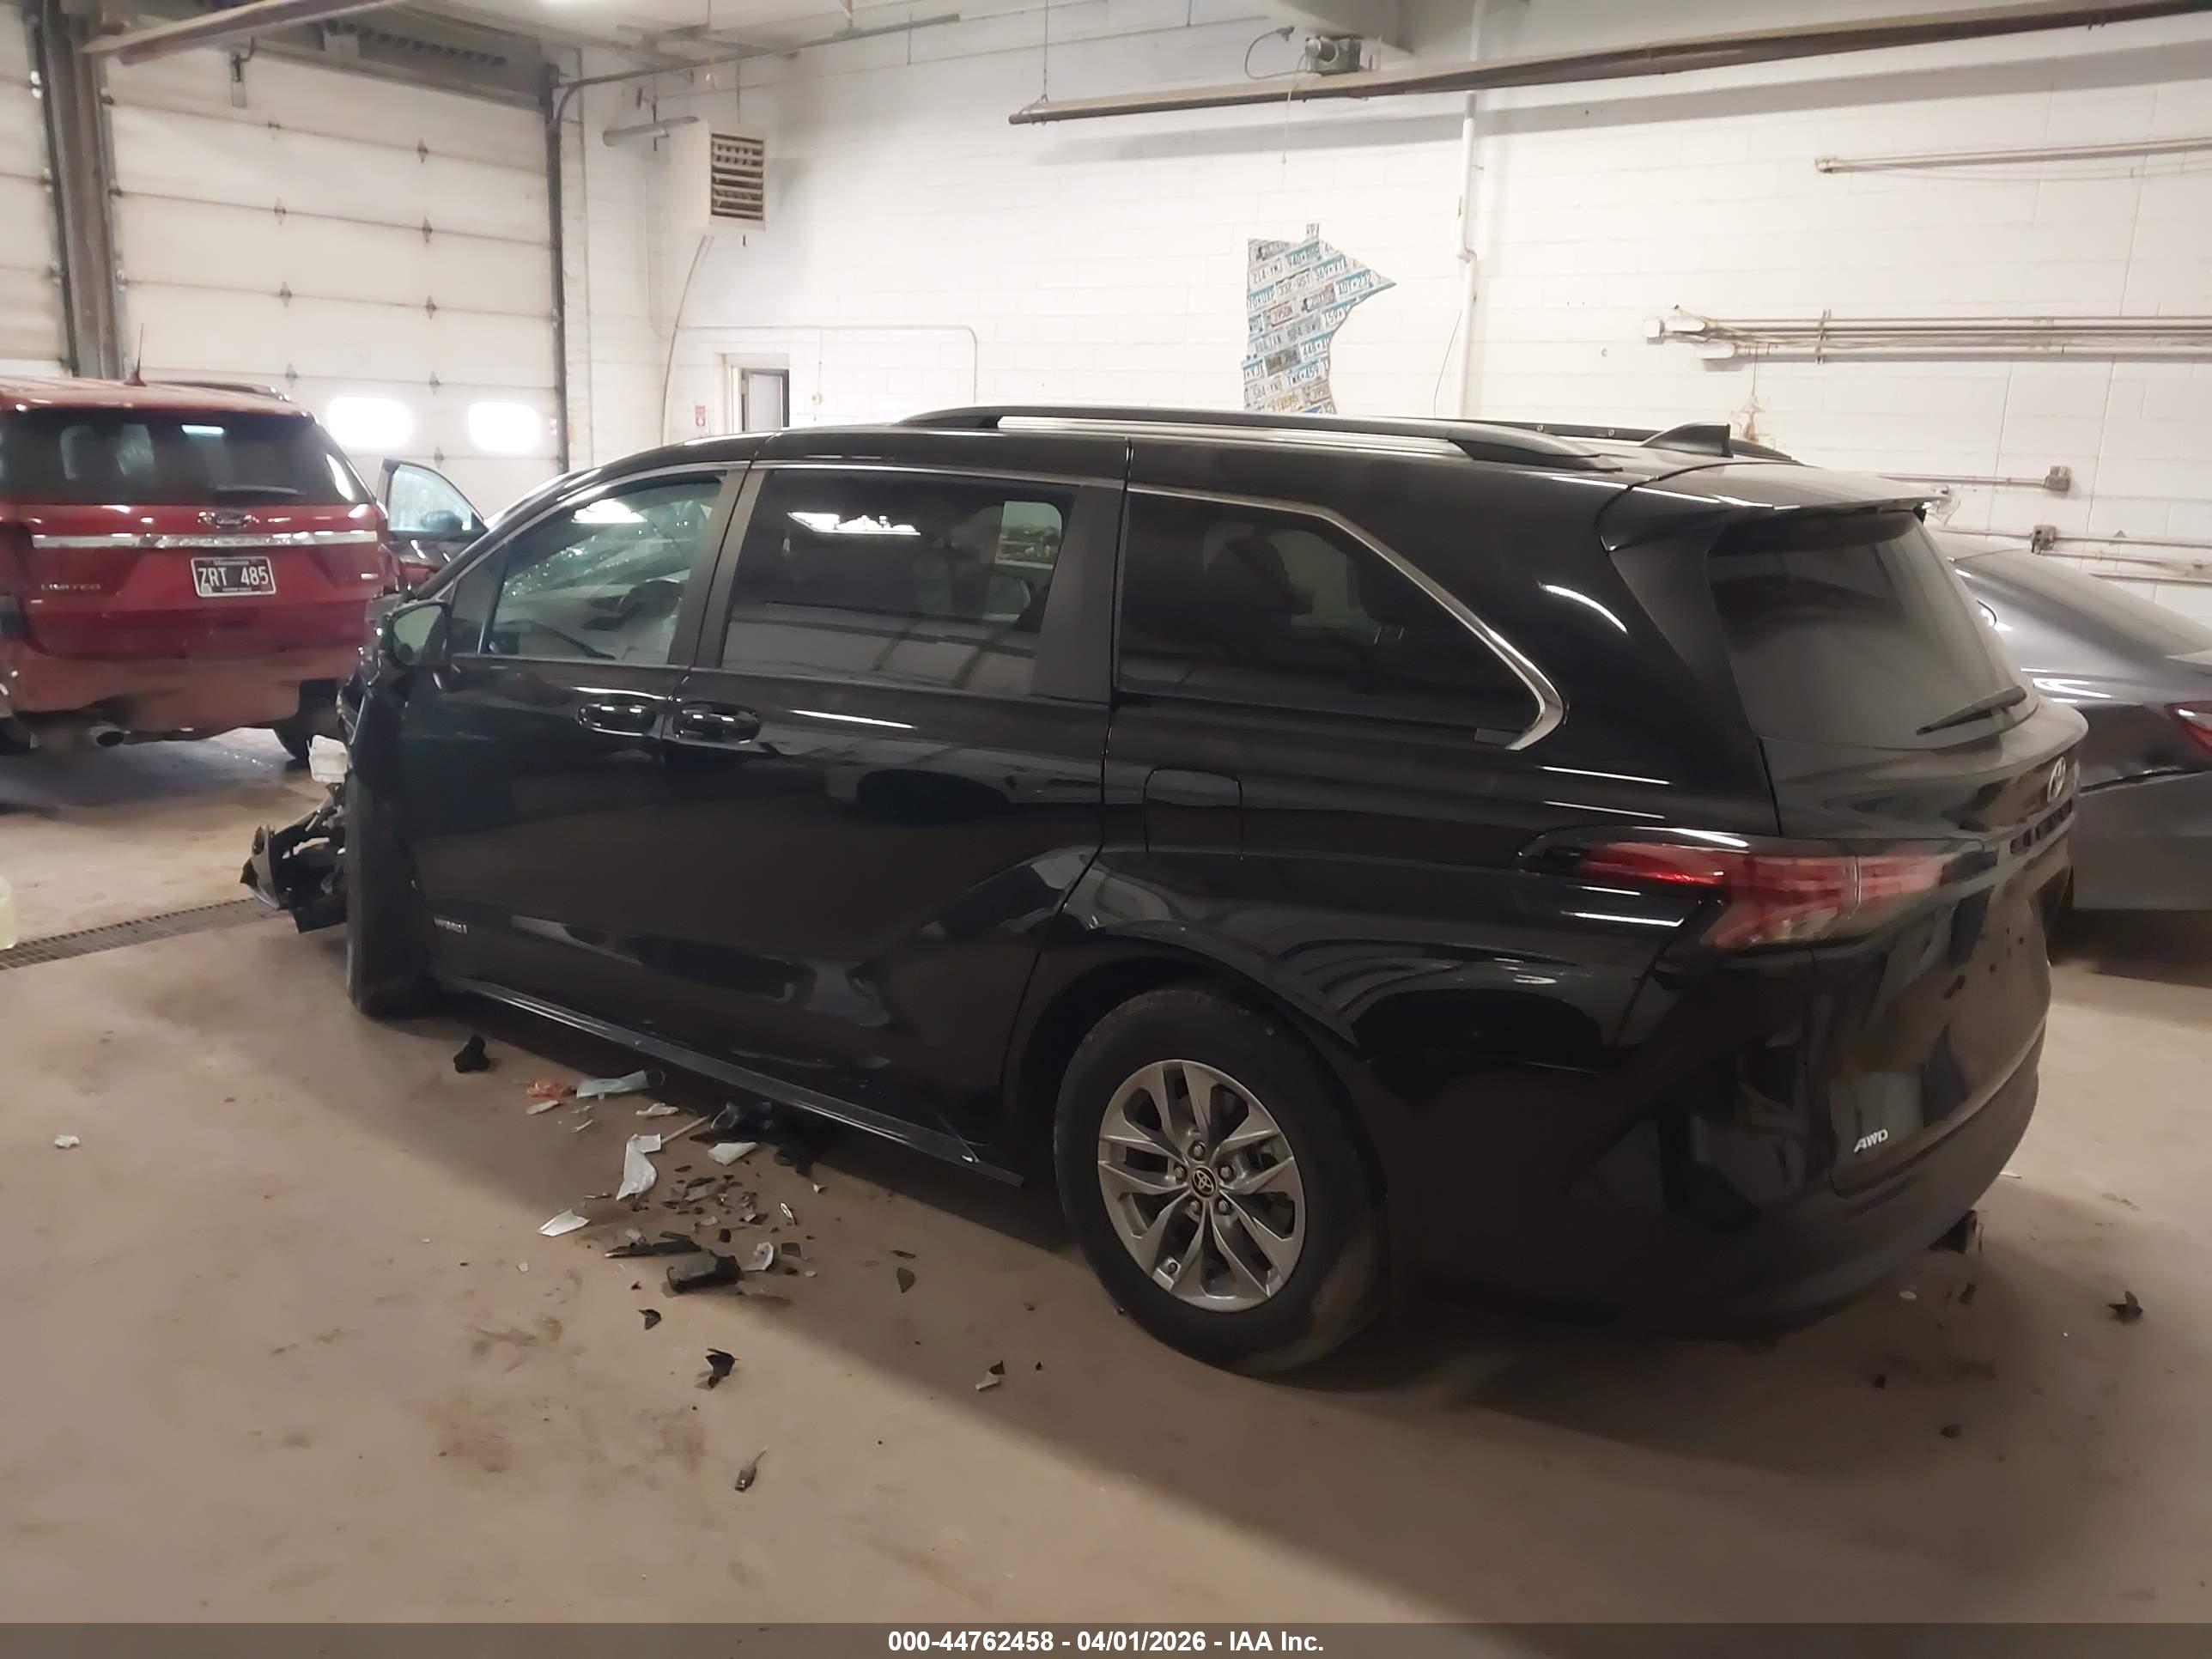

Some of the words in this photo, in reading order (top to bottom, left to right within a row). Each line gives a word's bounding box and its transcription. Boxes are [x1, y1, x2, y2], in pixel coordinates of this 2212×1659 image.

[198, 567, 228, 586] ZRT
[240, 566, 269, 586] 485
[1853, 1128, 1889, 1153] AWD
